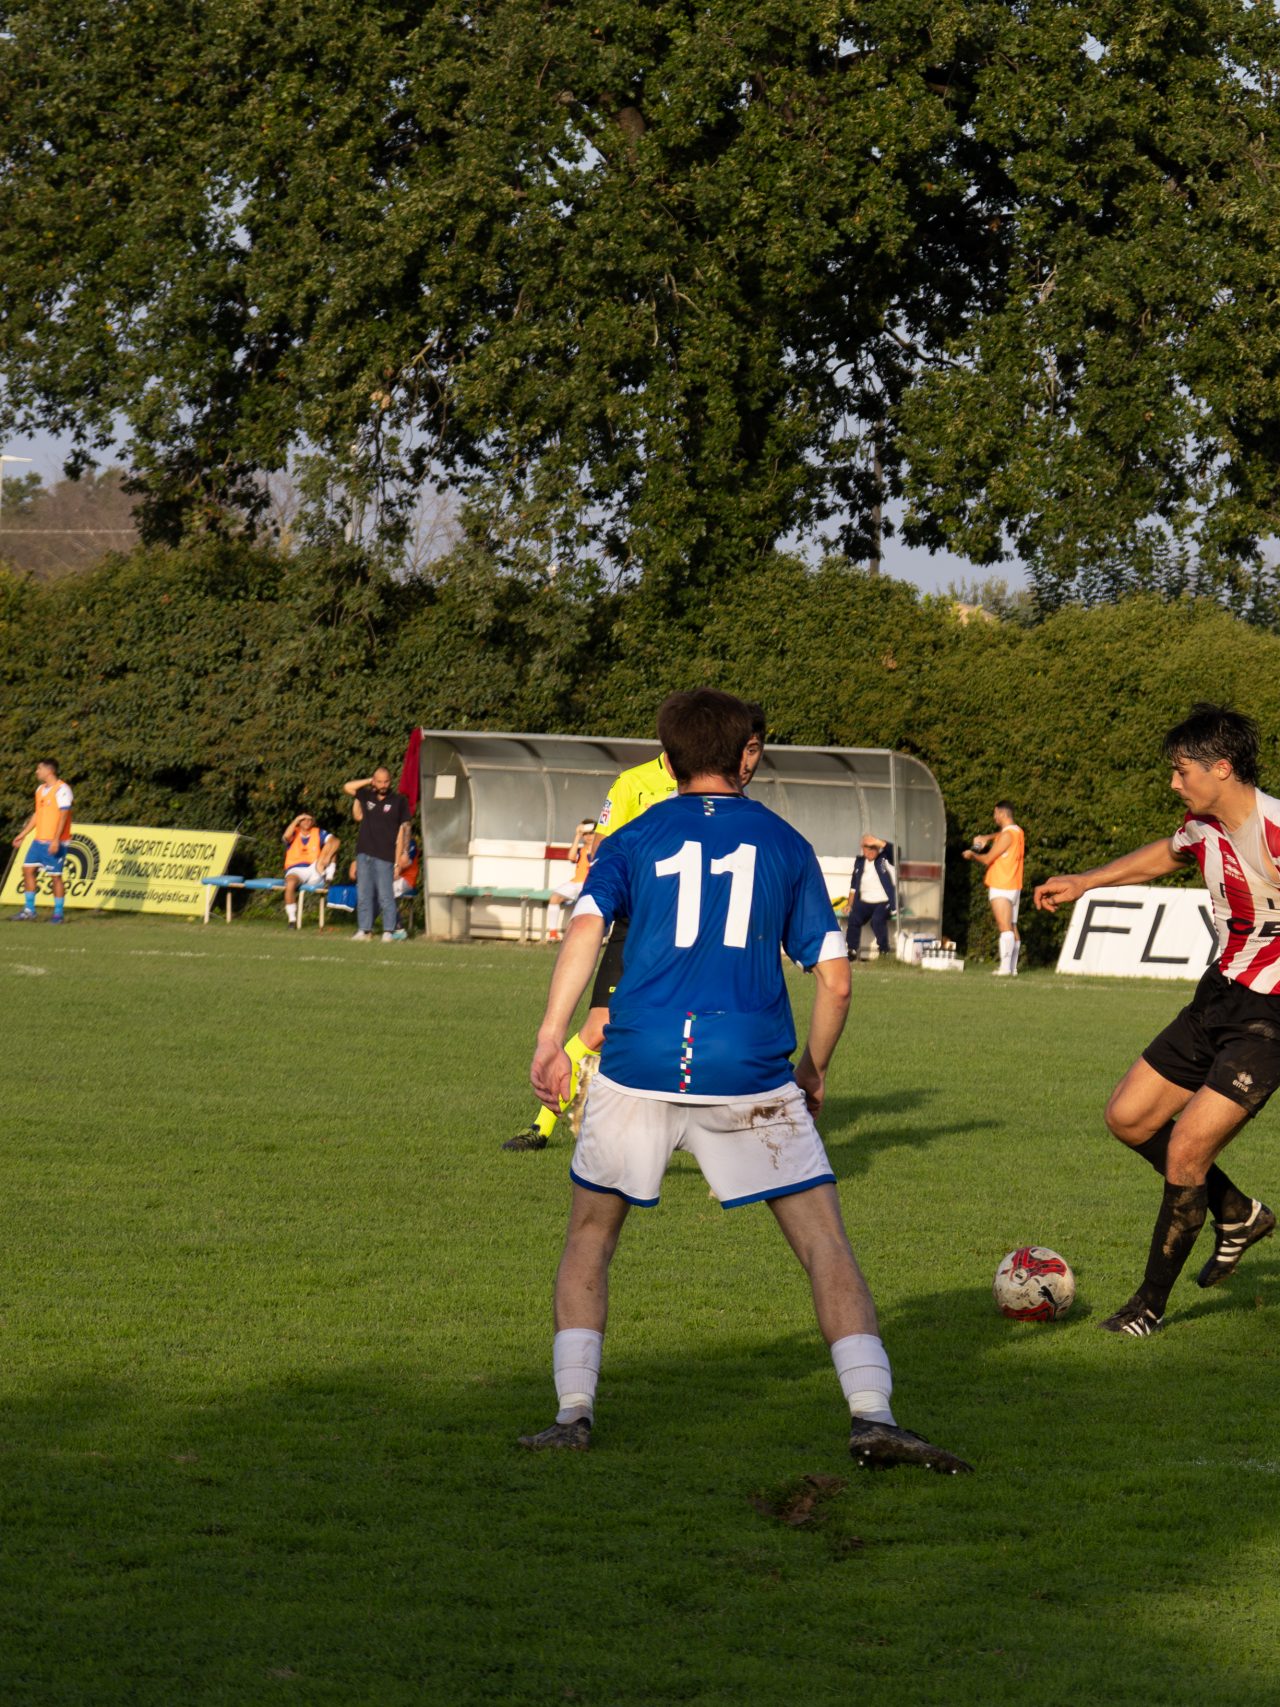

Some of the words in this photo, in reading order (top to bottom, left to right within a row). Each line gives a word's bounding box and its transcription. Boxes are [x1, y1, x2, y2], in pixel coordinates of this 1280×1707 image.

[113, 838, 164, 857] TRASPORTI
[162, 841, 172, 857] E
[170, 842, 217, 860] LOGISTICA
[103, 859, 165, 879] ARCHIVIAZIONE
[162, 864, 210, 880] DOCUMENTI
[95, 888, 200, 903] www.essecilogistica.it
[655, 840, 757, 949] 11
